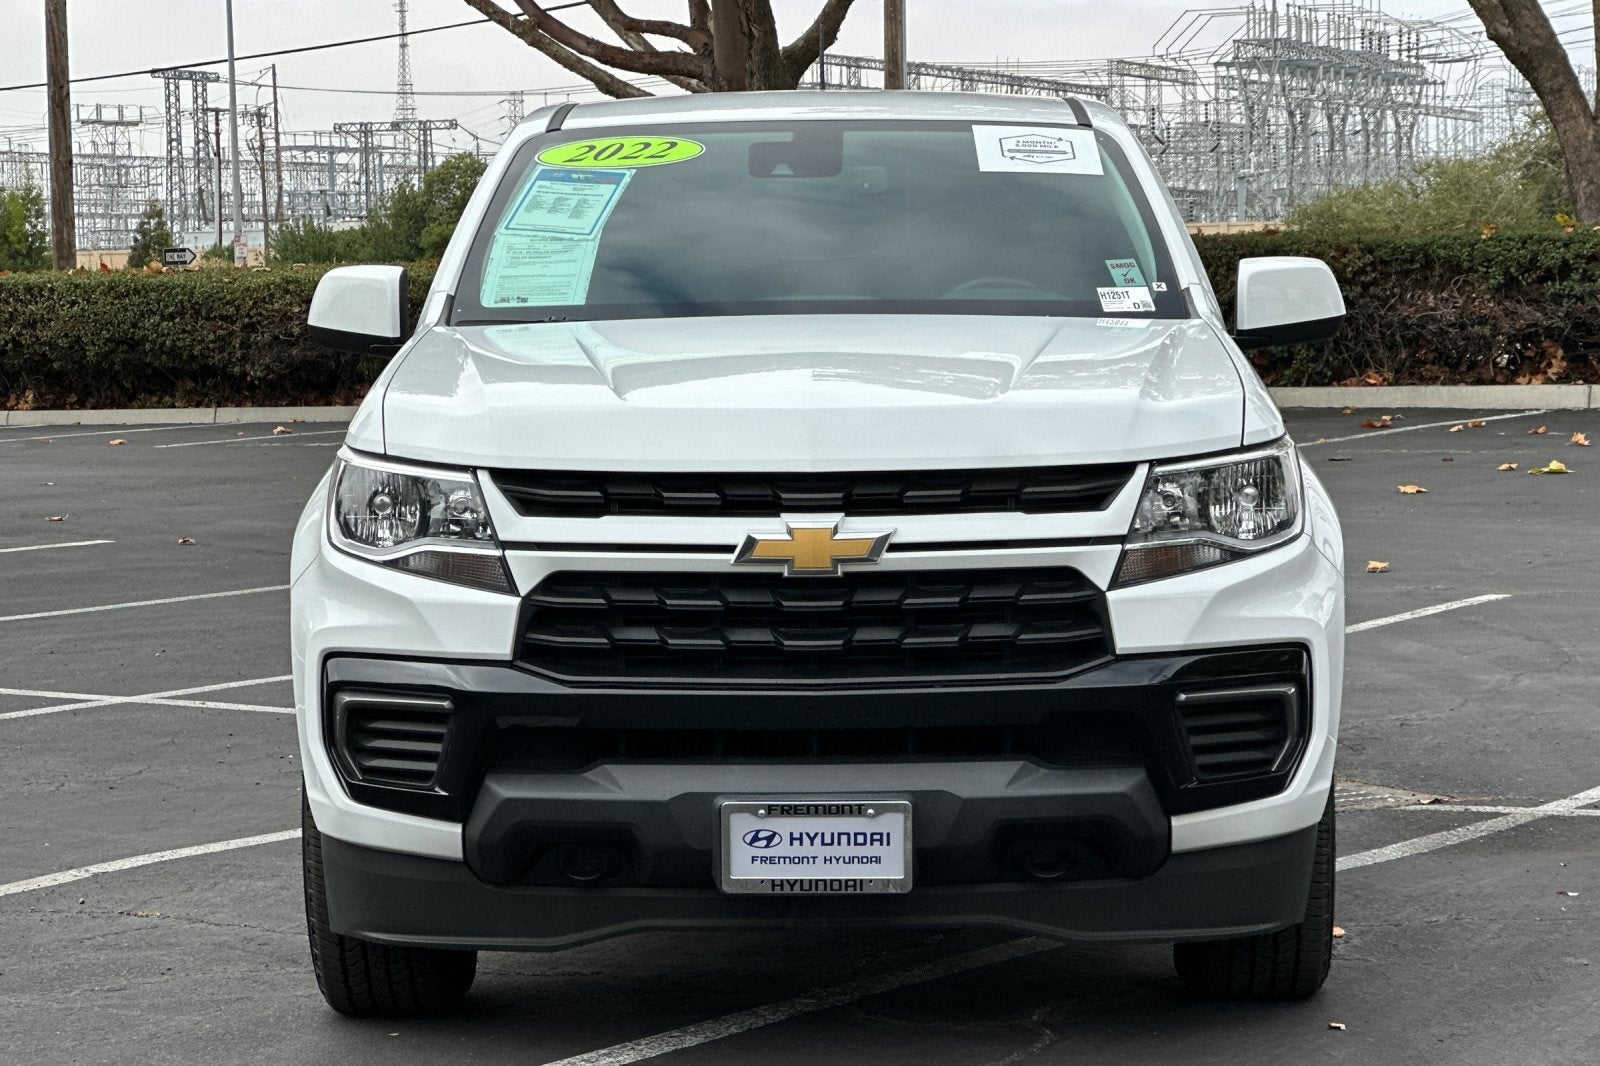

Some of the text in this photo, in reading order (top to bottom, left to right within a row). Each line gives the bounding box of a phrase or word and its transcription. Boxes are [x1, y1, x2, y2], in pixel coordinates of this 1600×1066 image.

[563, 141, 679, 164] 2022
[1109, 262, 1136, 270] SMOG
[1100, 290, 1131, 300] H1251T
[1132, 302, 1141, 310] D
[767, 804, 866, 816] FREMONT
[789, 831, 891, 847] HYUNDAI
[751, 855, 882, 865] FREMONT HYUNDAI
[771, 879, 864, 892] HYUNDAI
